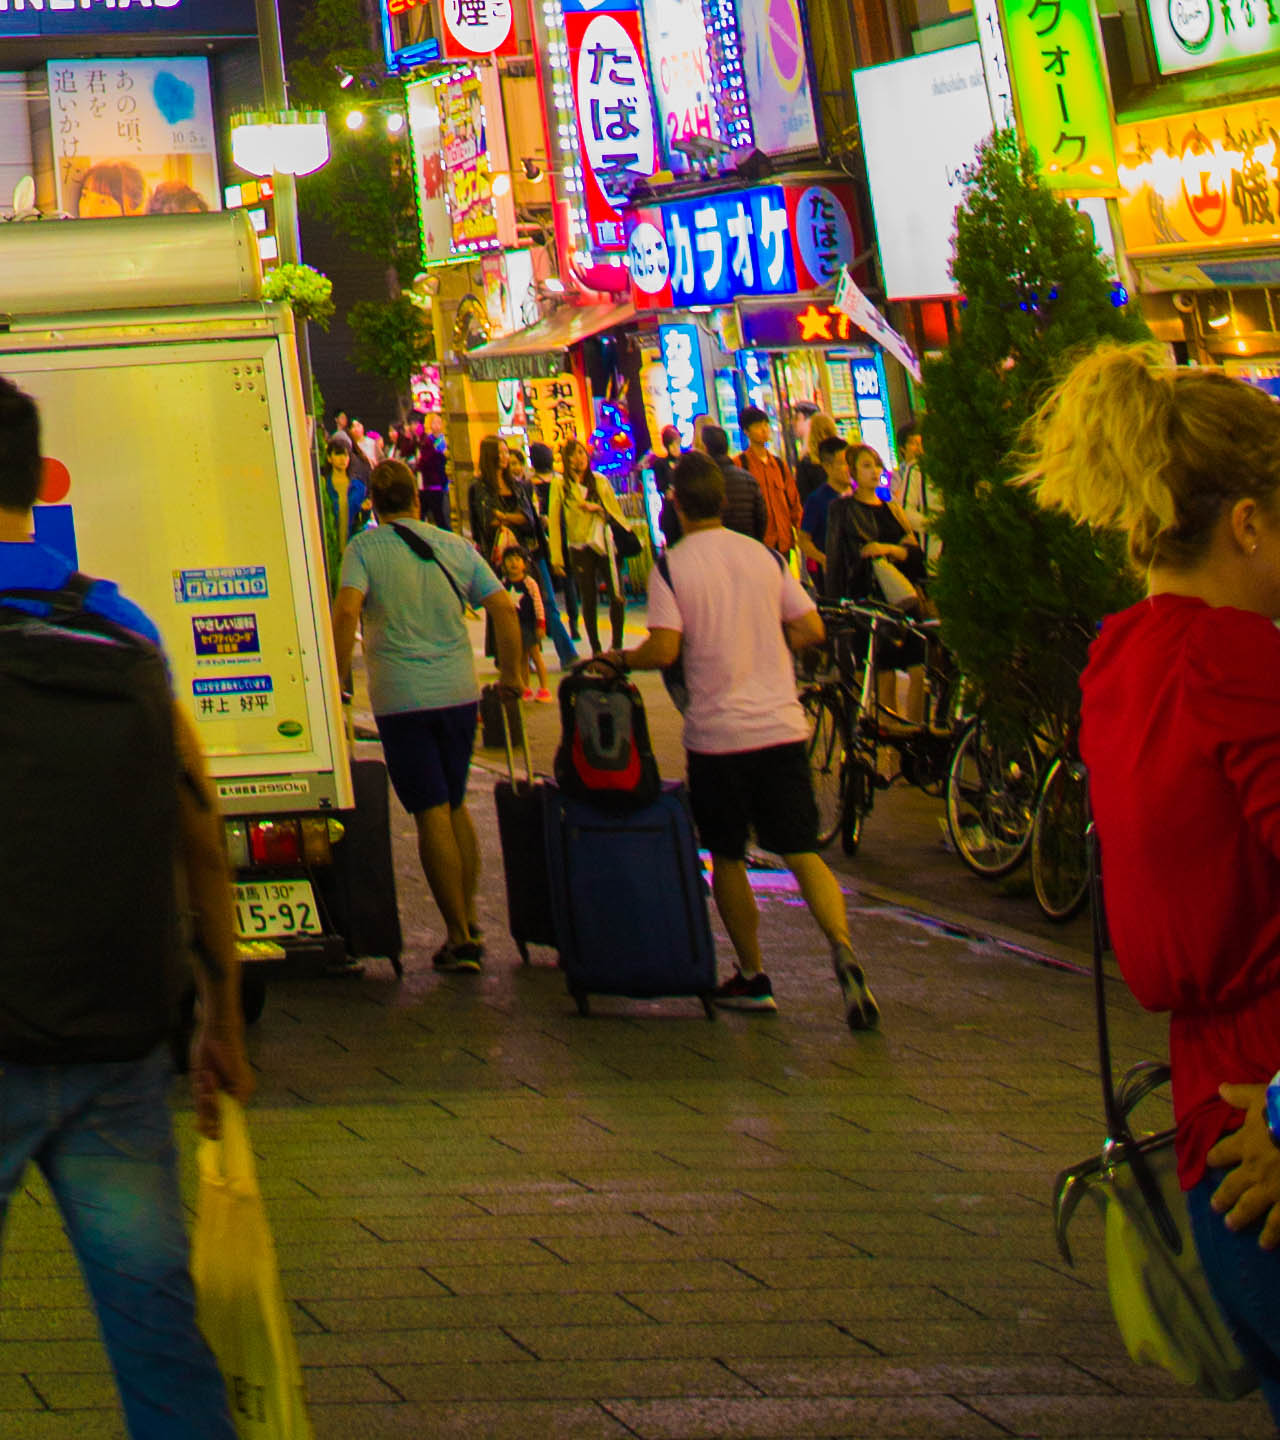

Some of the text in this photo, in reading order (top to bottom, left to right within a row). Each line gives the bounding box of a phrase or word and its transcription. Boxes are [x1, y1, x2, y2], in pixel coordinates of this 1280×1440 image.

[87, 69, 107, 119] 君を
[670, 198, 789, 295] カラオケ
